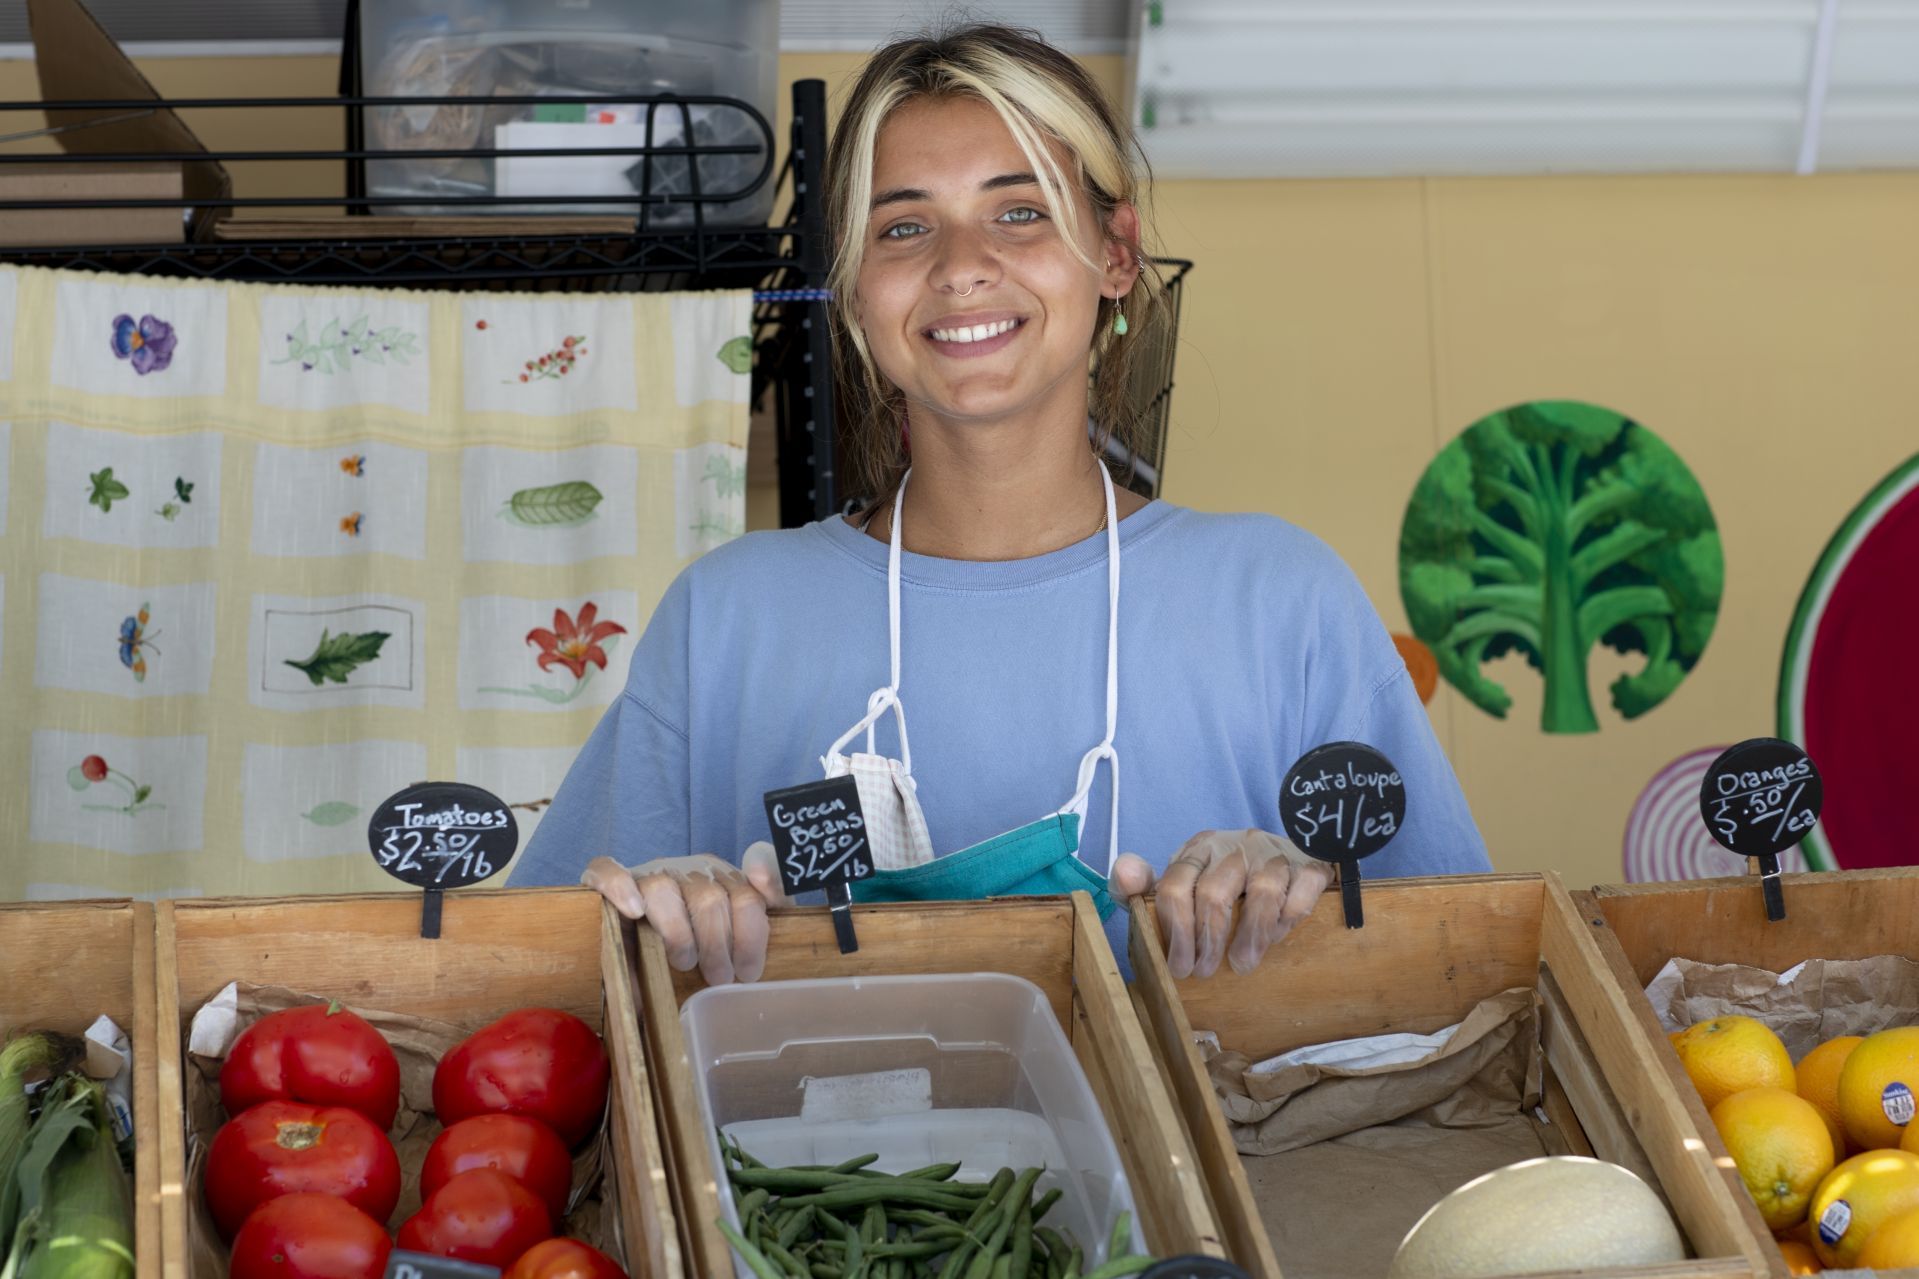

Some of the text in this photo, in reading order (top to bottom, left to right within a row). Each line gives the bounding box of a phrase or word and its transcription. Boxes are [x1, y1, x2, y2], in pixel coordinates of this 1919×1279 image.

[1290, 761, 1402, 799] Cantaloupe
[1717, 757, 1810, 796] Oranges
[394, 803, 508, 830] Tomatoes
[773, 798, 846, 828] Green
[789, 812, 864, 846] Beans
[1294, 793, 1397, 849] $4/ea
